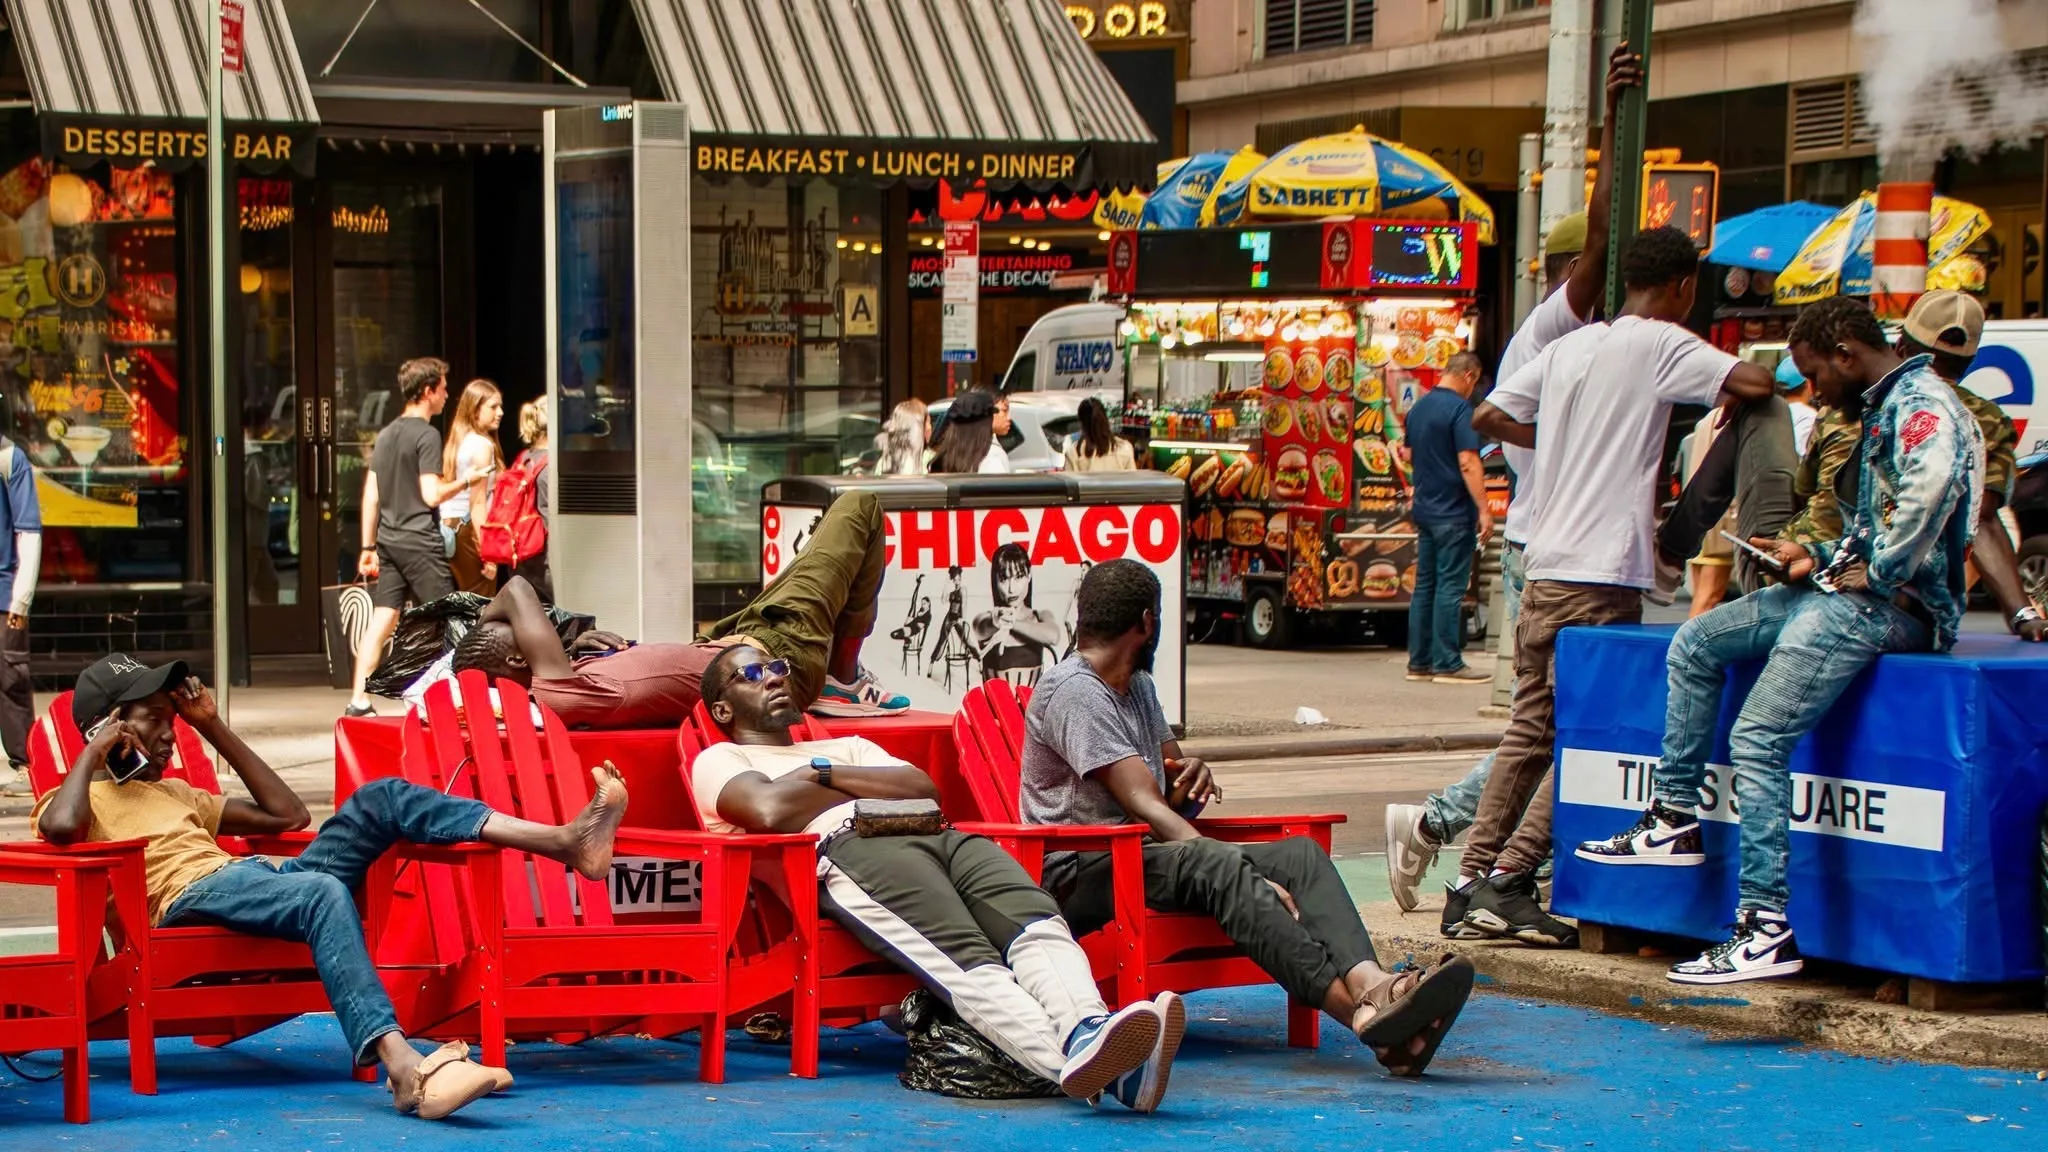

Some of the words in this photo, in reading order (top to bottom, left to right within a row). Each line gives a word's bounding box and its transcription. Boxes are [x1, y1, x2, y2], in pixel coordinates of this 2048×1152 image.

[65, 127, 208, 157] DESSERTS
[234, 134, 292, 160] BAR
[697, 146, 849, 174] BREAKFAST
[872, 151, 959, 176] LUNCH
[982, 154, 1075, 178] DINNER
[1257, 185, 1371, 208] SABRETT
[980, 255, 1072, 270] TERTAINING
[851, 294, 872, 322] A
[58, 320, 157, 336] HARRISON
[1055, 341, 1114, 376] STANCO
[1403, 386, 1414, 401] A
